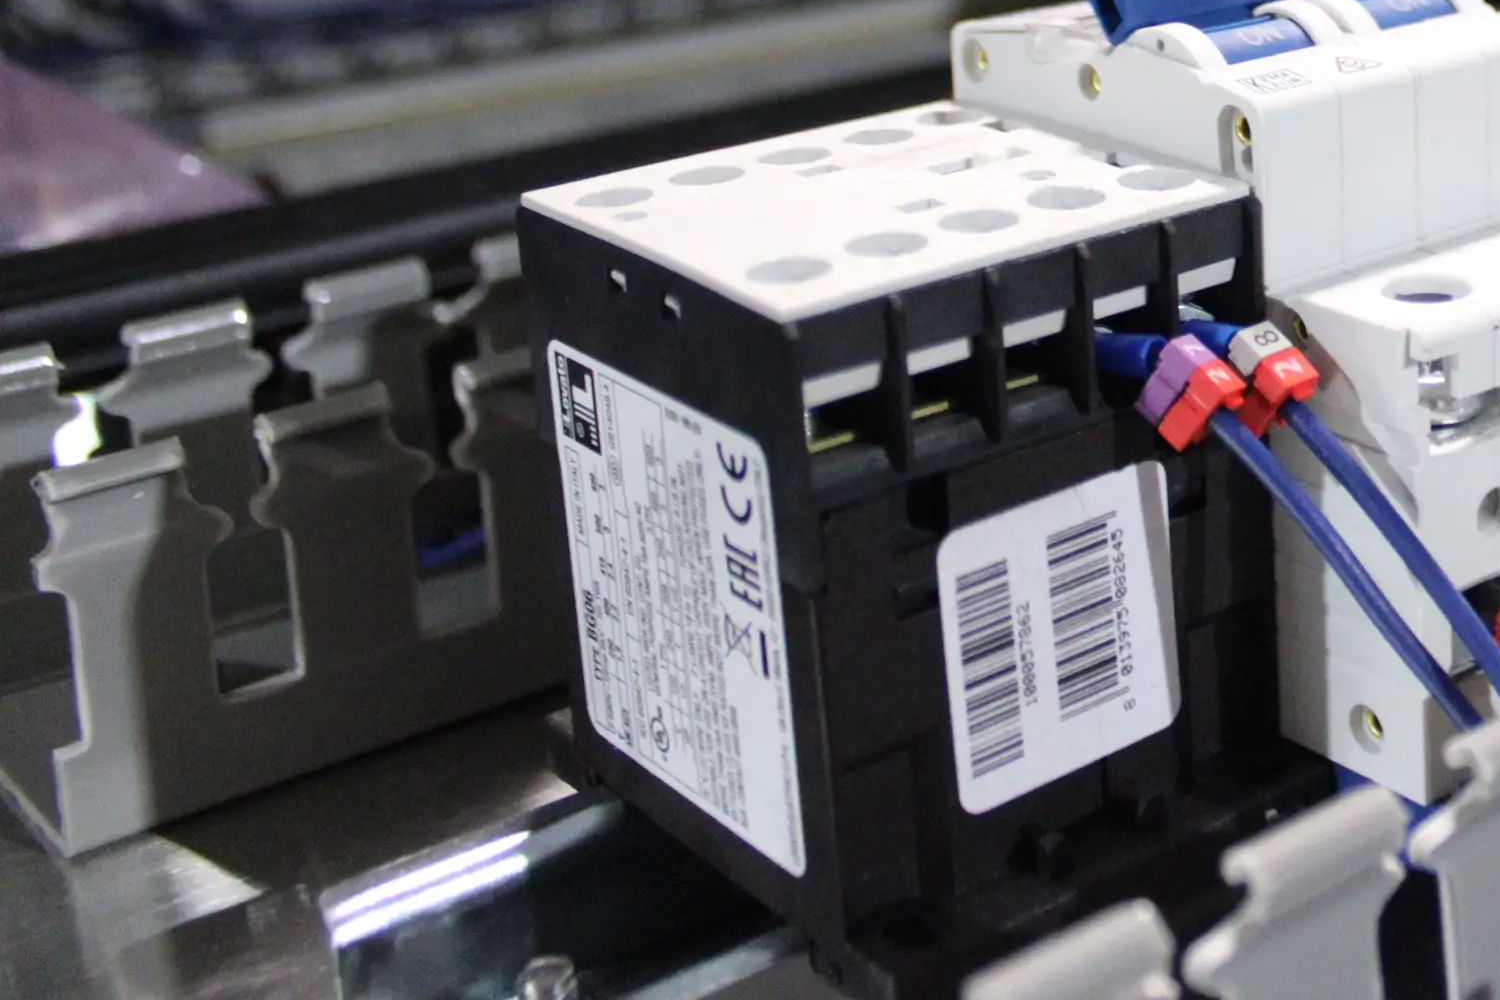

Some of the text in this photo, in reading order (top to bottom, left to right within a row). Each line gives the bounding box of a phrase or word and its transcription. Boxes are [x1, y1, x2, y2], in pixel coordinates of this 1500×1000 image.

[1240, 26, 1284, 45] ON
[556, 352, 571, 424] Lovato
[715, 439, 763, 613] EAC CE
[1107, 526, 1129, 600] 082645
[581, 586, 598, 644] BG06
[1114, 604, 1134, 677] 013975
